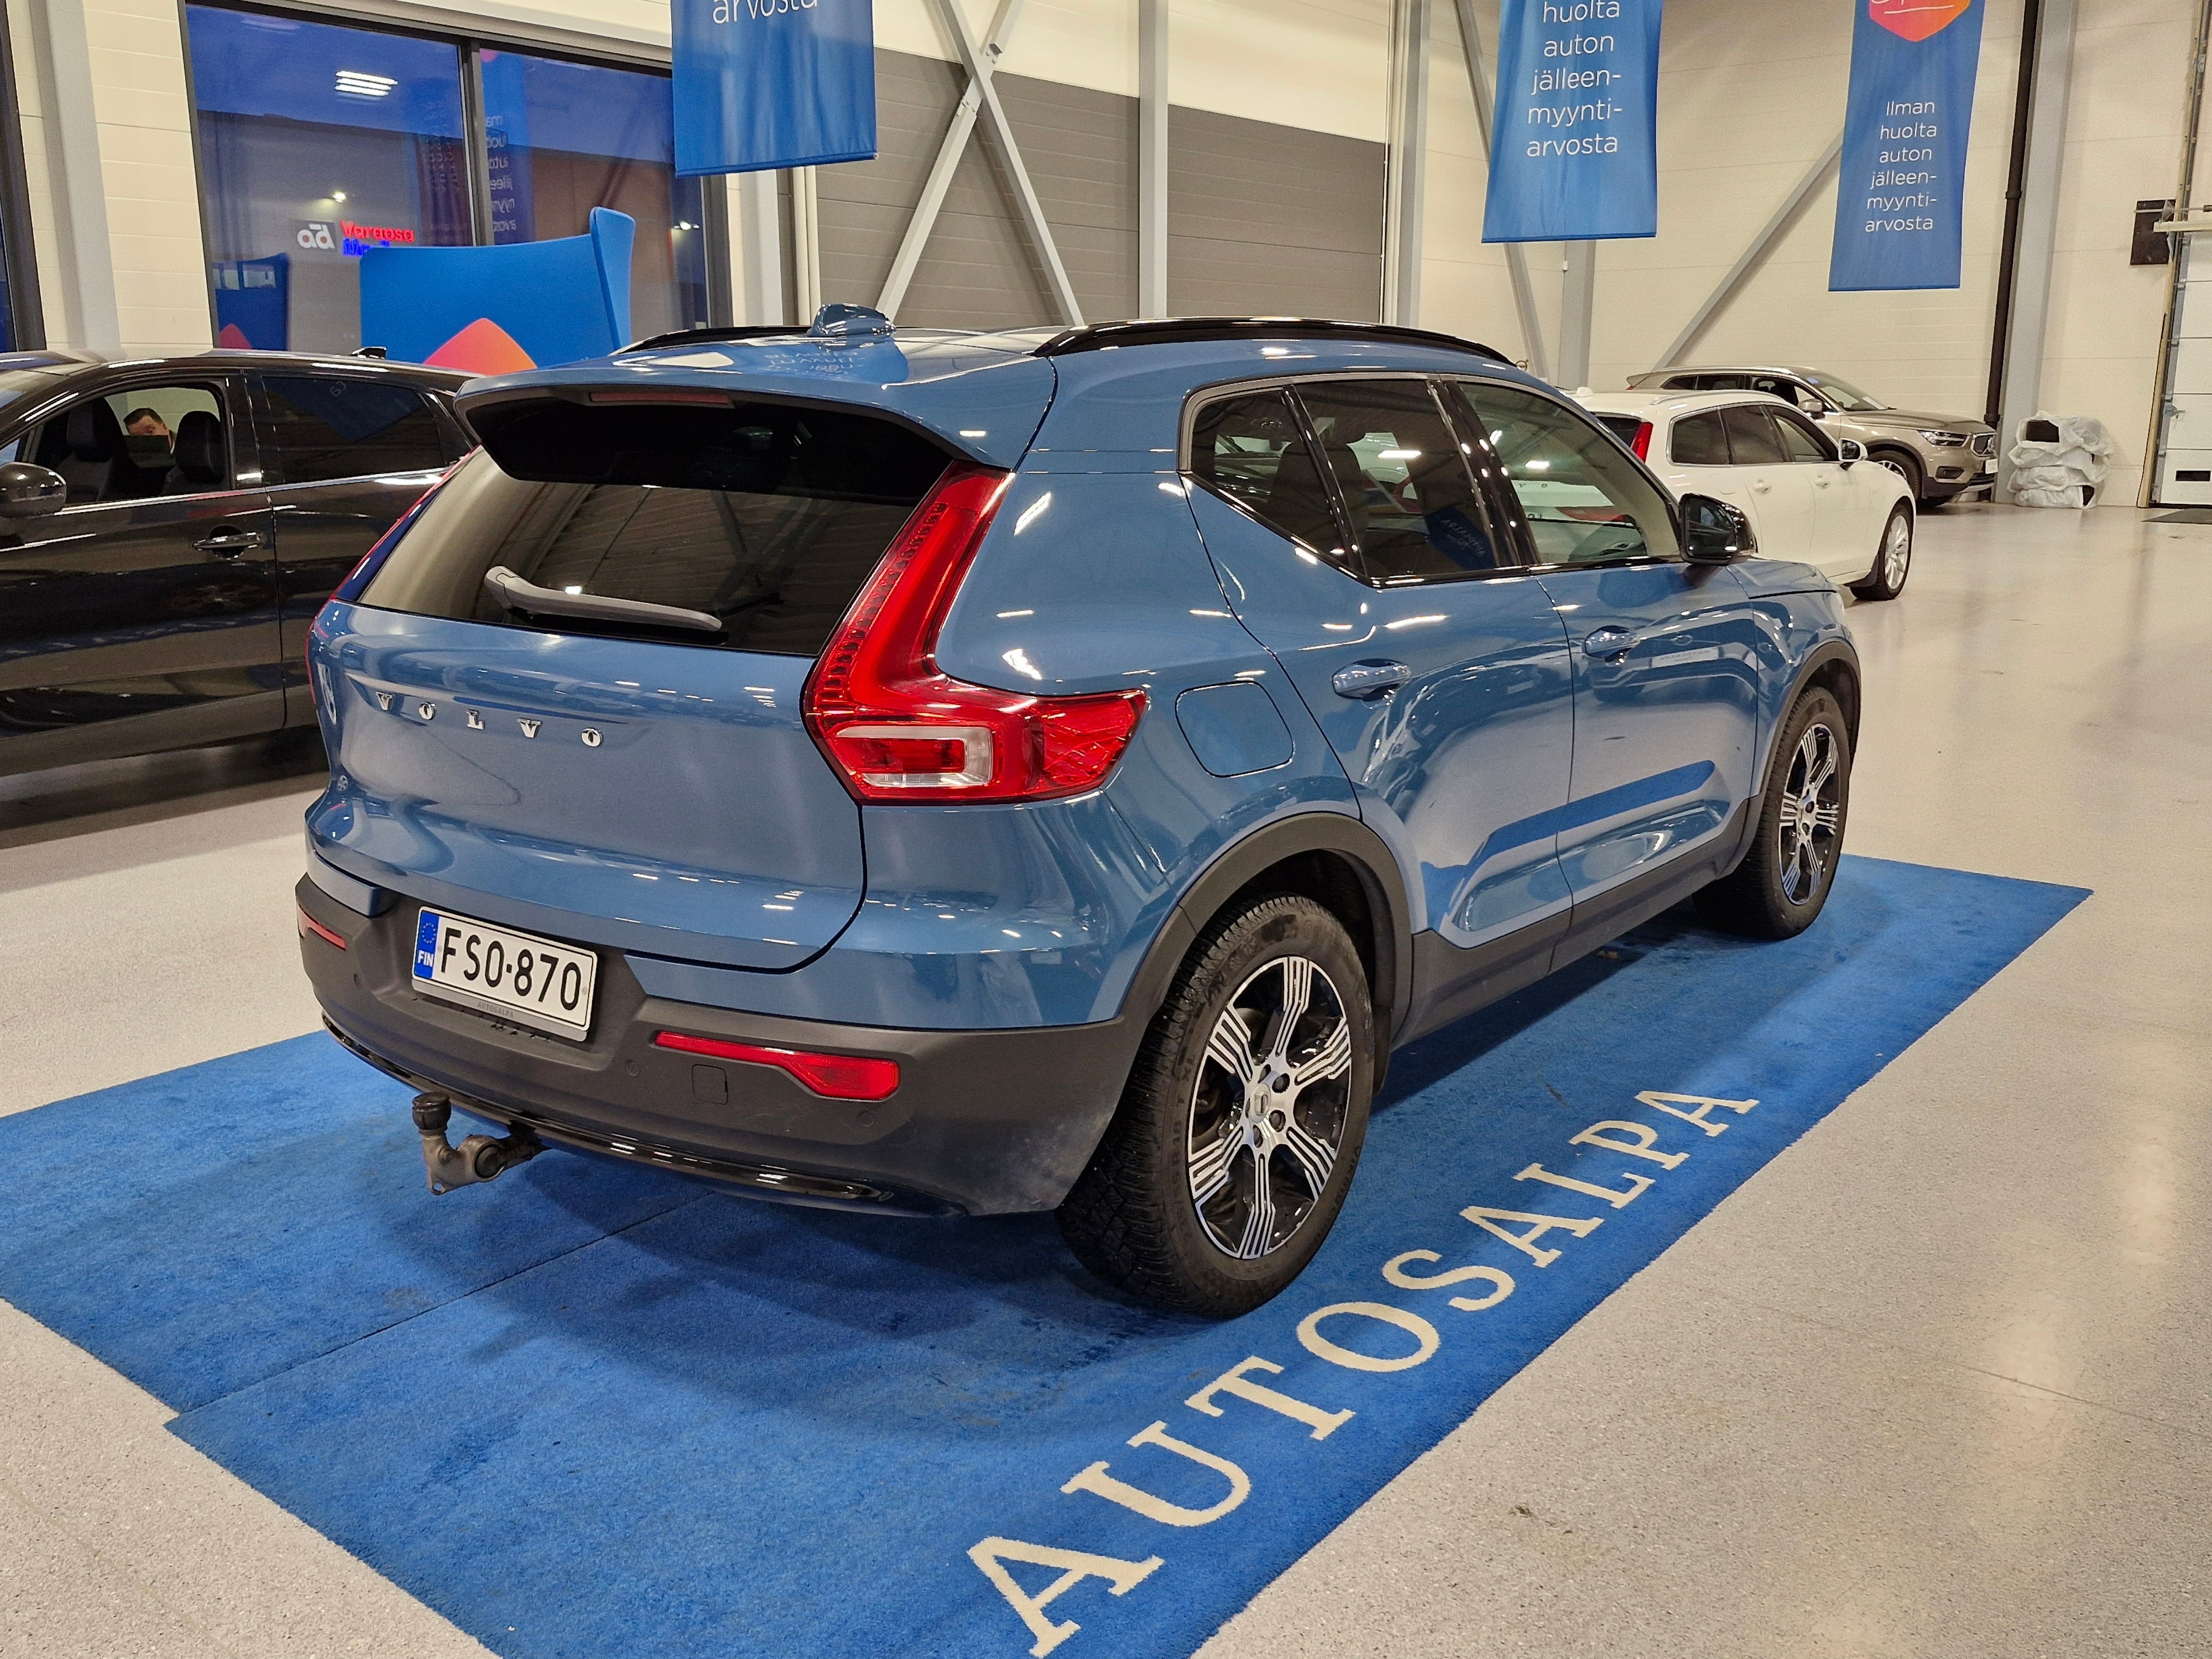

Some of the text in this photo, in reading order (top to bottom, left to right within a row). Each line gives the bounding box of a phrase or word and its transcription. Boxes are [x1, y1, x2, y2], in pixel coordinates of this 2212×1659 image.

[1542, 0, 1620, 23] huolta
[1543, 35, 1614, 57] auton
[1531, 67, 1621, 95] jälleen-
[1527, 98, 1623, 128] myynti-
[1886, 101, 1935, 117] Ilman
[1880, 122, 1937, 140] huolta
[1526, 133, 1618, 157] arvosta
[1879, 147, 1932, 163] auton
[1869, 169, 1937, 190] jälleen-
[1866, 191, 1938, 211] myynti-
[1865, 216, 1934, 233] arvosta
[375, 691, 603, 747] VOLVO
[418, 950, 434, 967] FIN
[477, 1001, 514, 1019] AUTOSALPA
[966, 1089, 1760, 1658] AUTOSALPA
